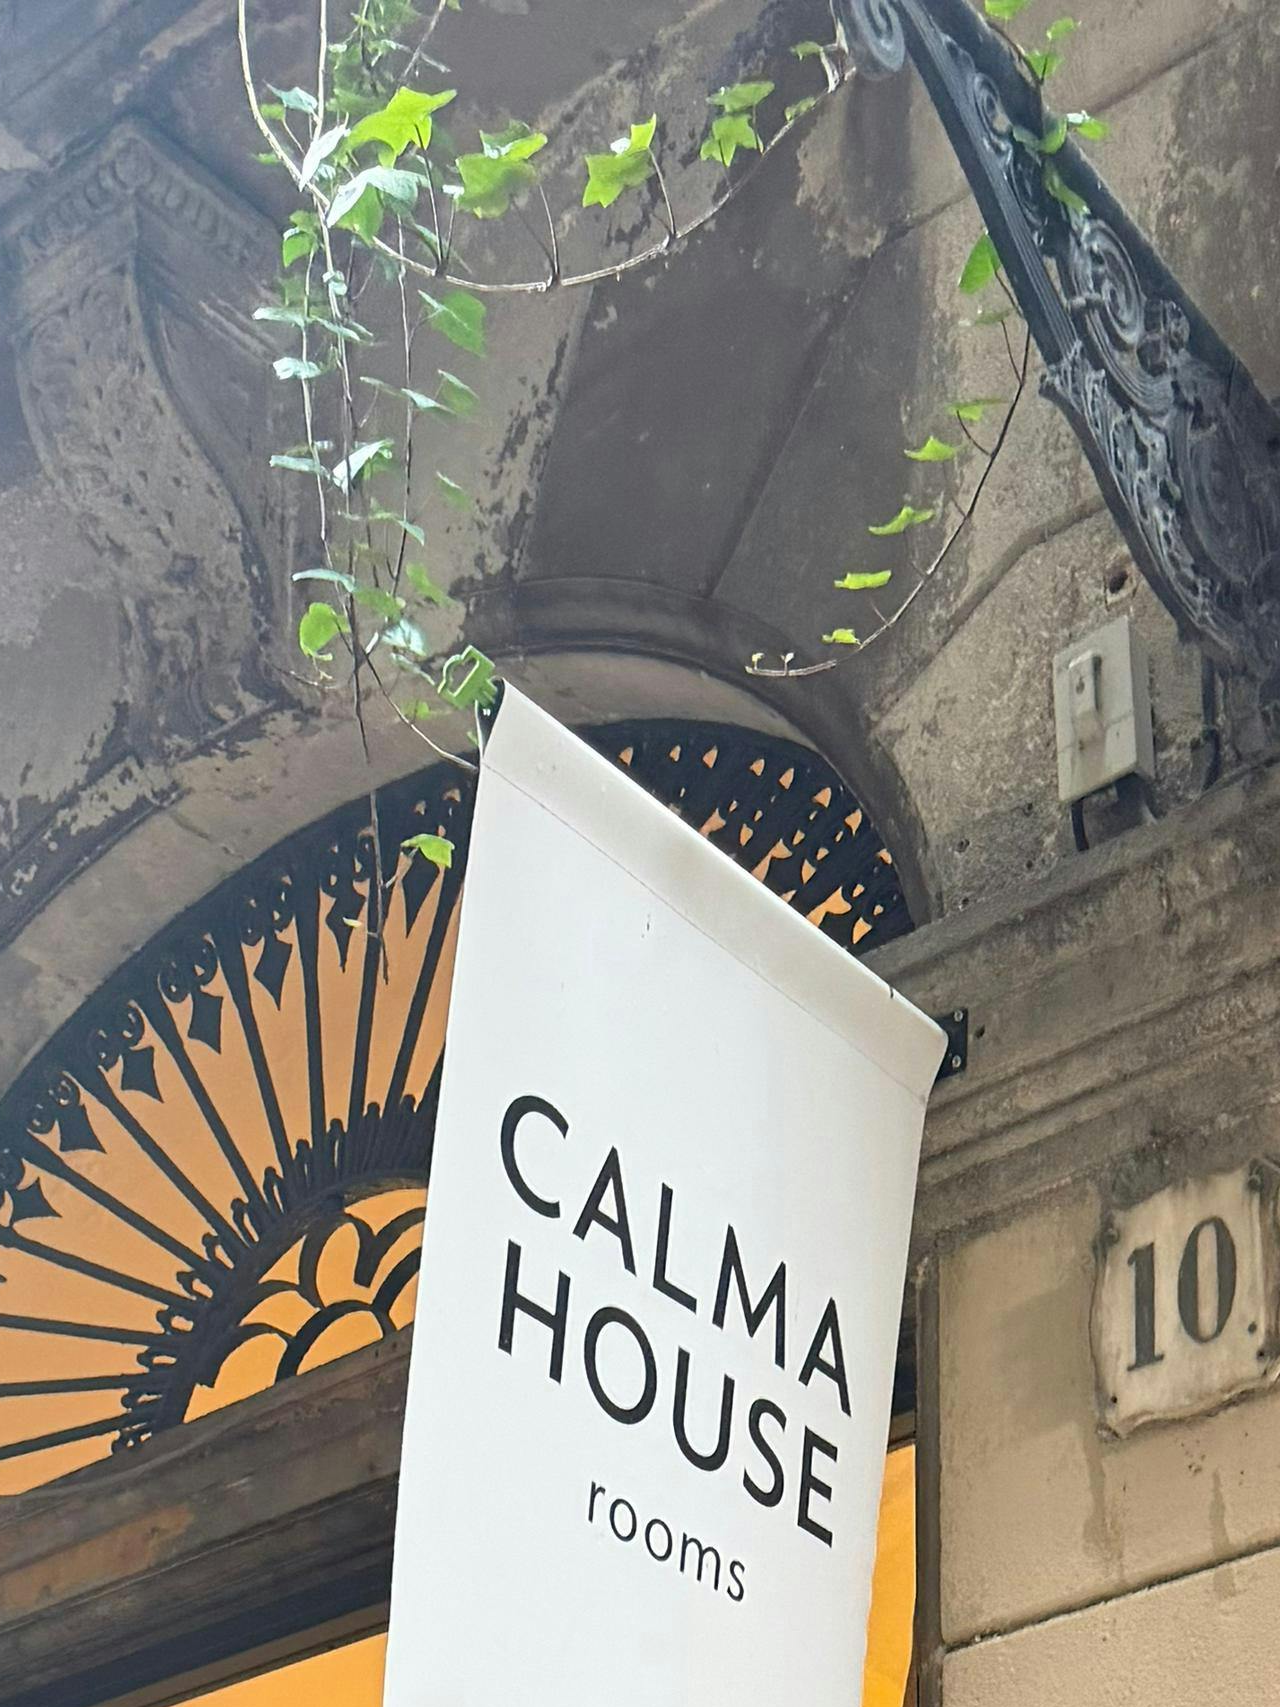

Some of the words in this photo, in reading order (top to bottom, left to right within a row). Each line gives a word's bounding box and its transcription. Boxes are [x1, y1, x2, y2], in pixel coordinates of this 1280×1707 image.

[498, 1239, 838, 1548] HOUSE
[500, 1094, 852, 1418] CALMA
[588, 1480, 746, 1603] rooms
